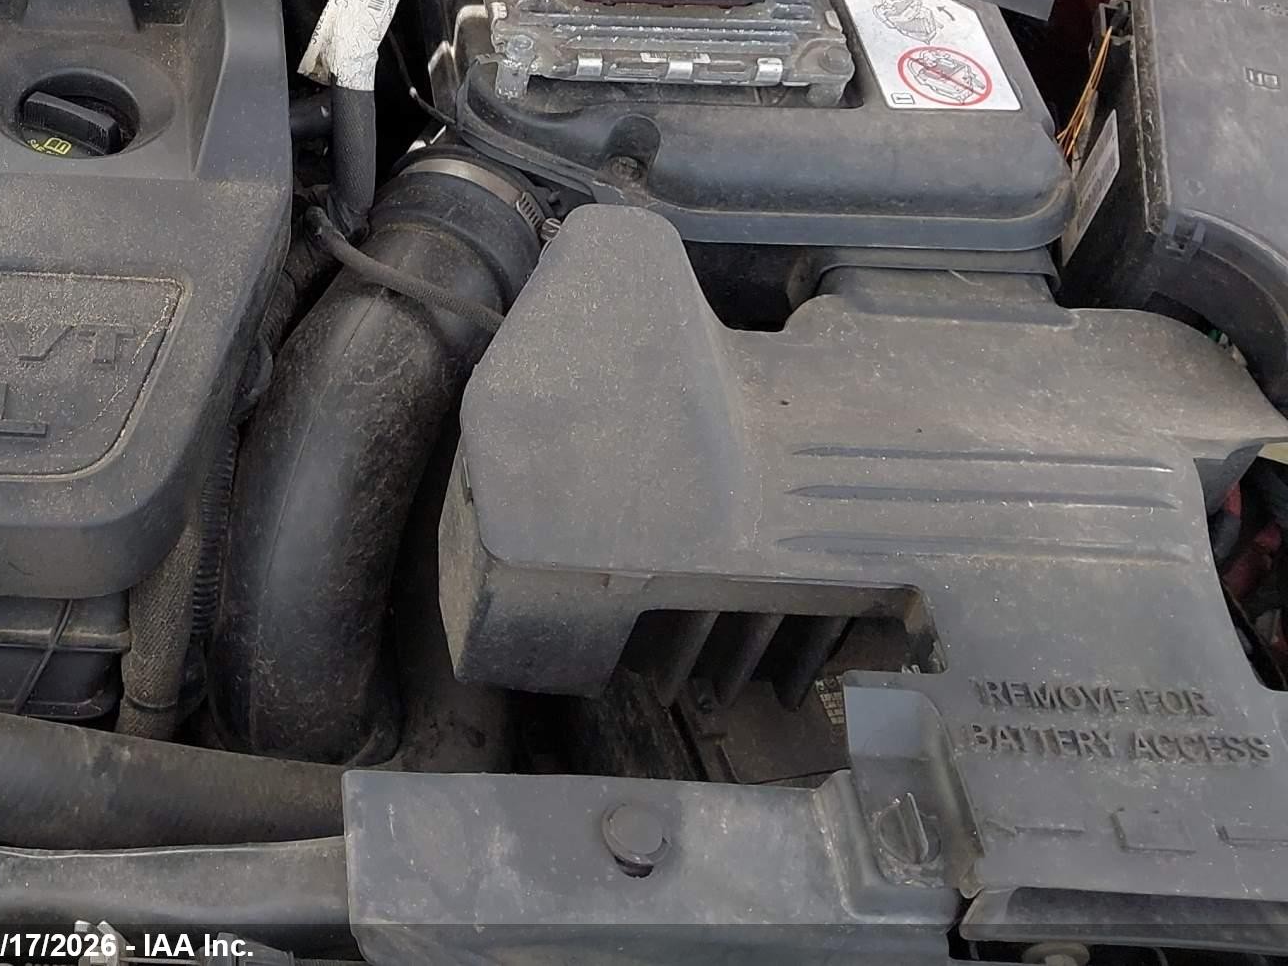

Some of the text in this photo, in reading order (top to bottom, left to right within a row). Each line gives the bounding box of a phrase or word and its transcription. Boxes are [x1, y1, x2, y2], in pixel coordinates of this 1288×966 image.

[972, 680, 1214, 717] REMOVE FOR
[970, 724, 1273, 762] BATTERY ACCESS
